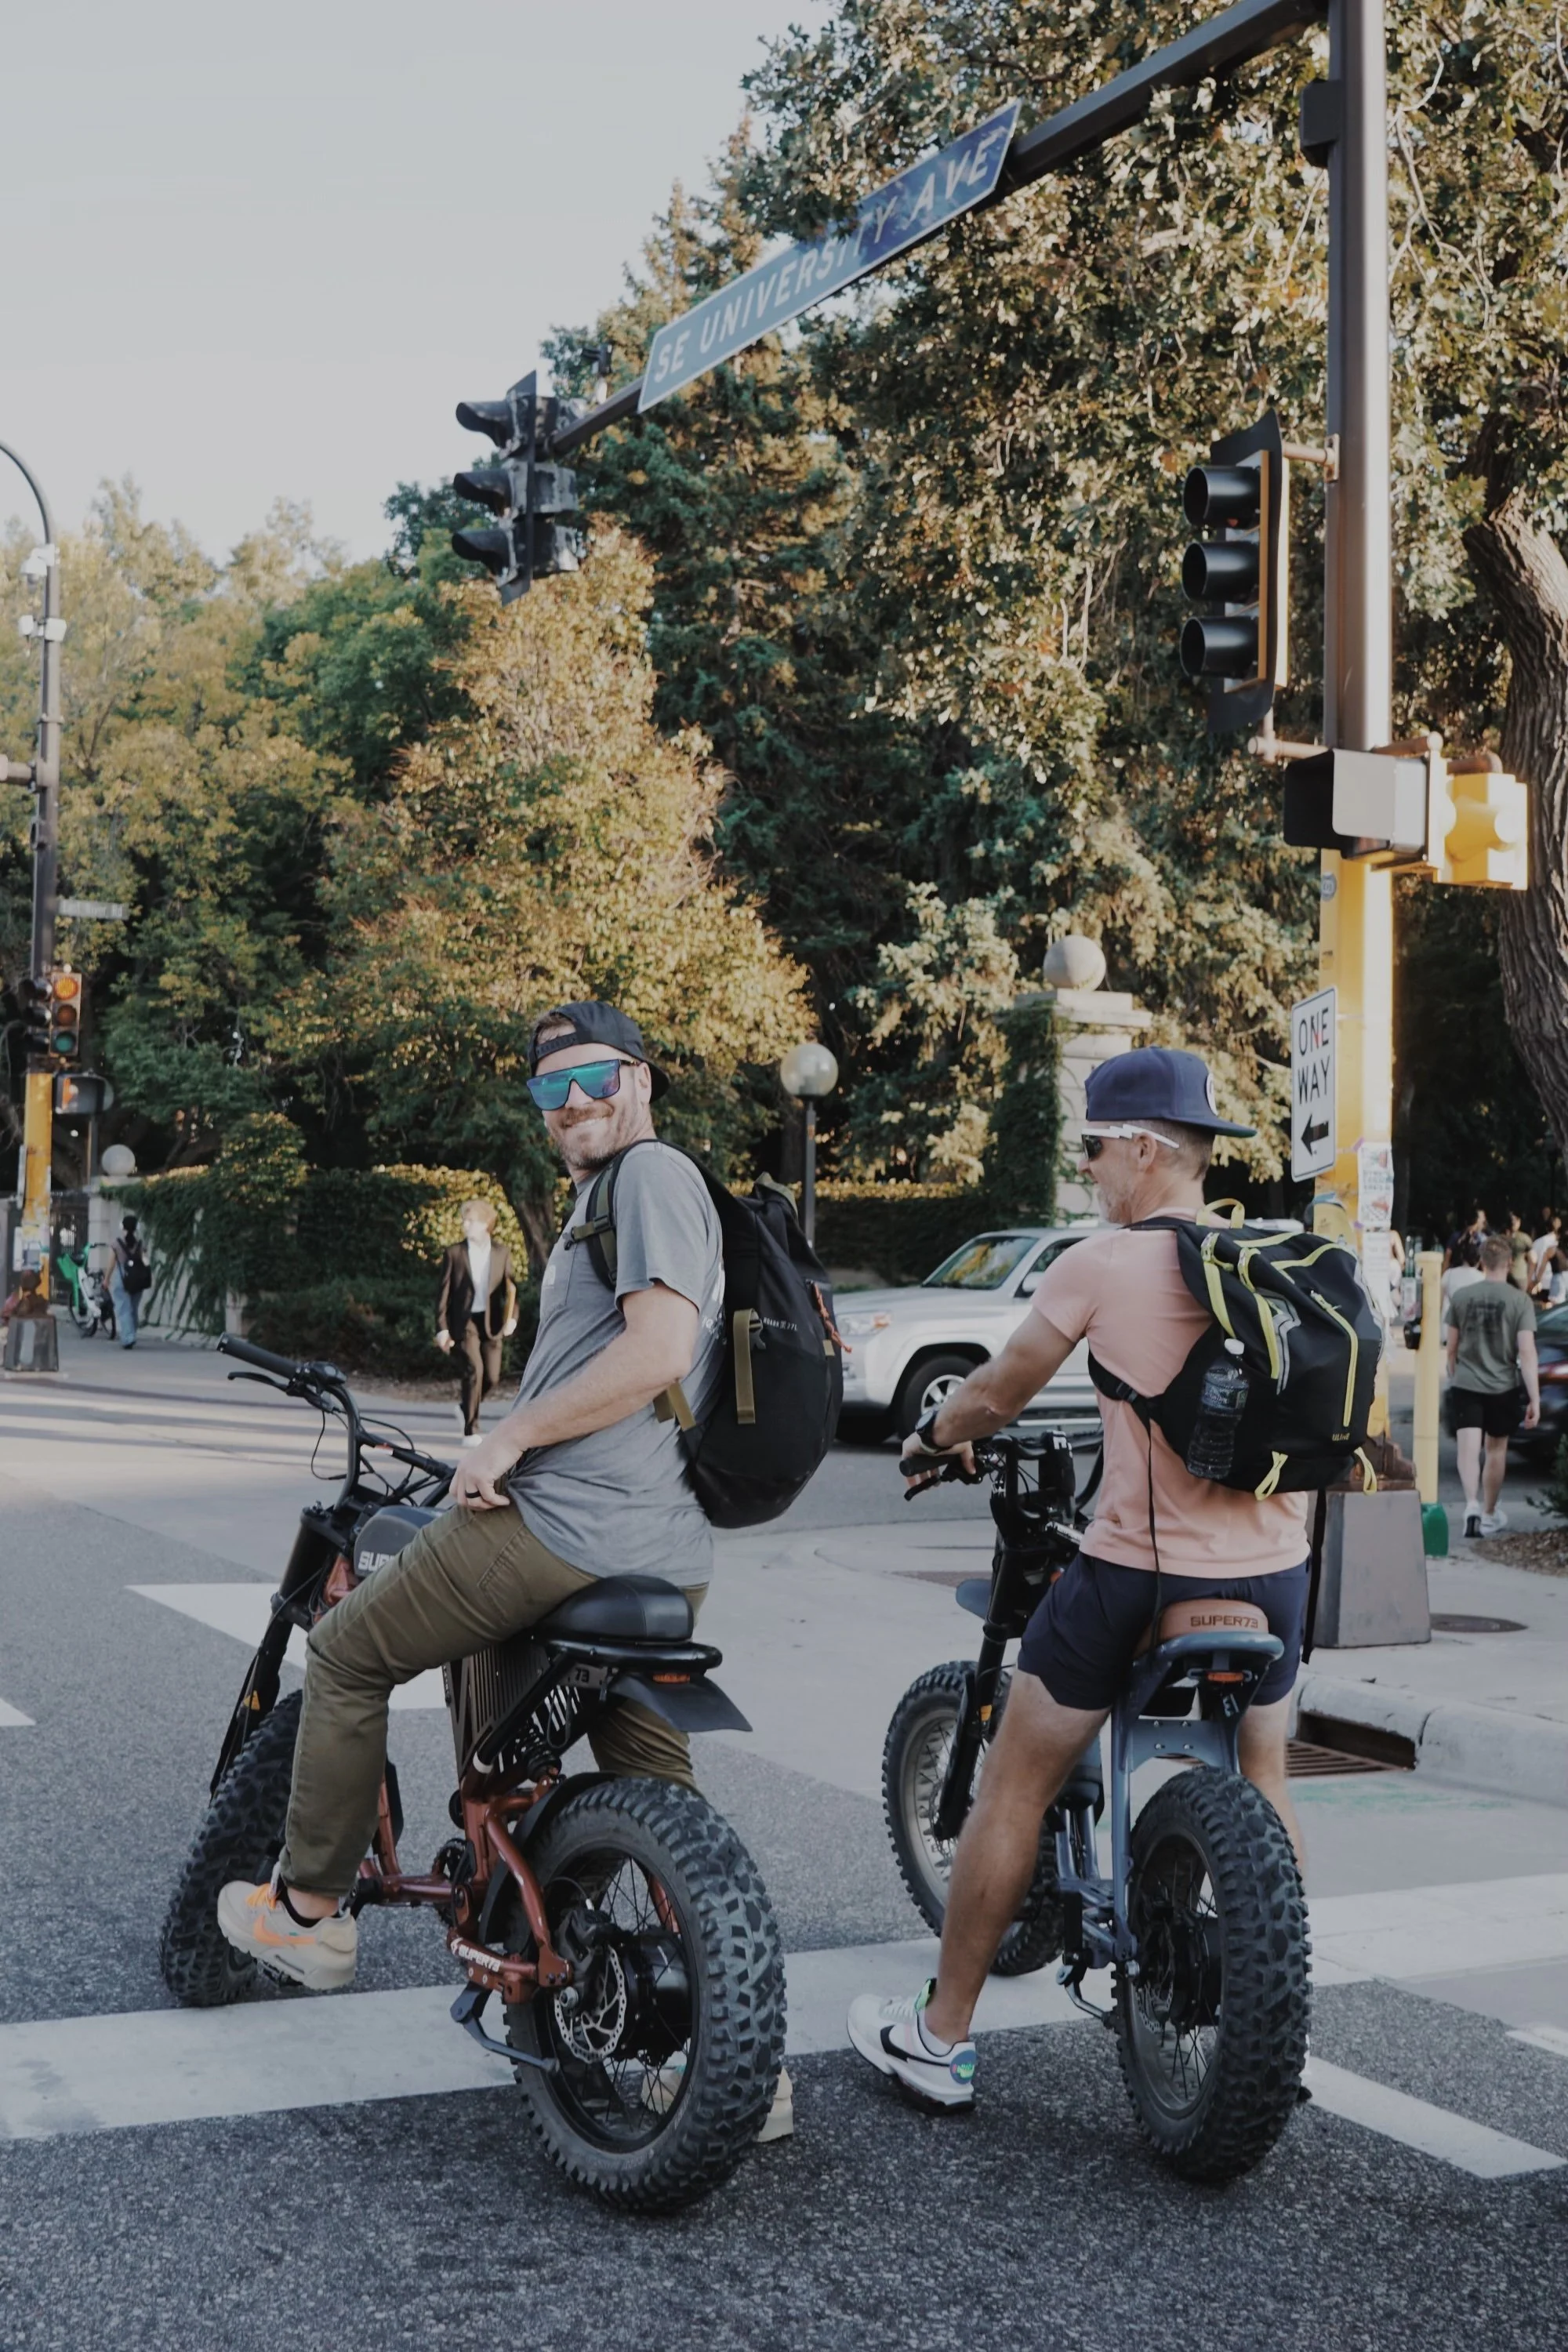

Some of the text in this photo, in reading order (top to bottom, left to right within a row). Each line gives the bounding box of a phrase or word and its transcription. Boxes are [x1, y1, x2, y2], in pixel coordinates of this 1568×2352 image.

[654, 136, 999, 383] SE UNIVERSITY AVE
[1298, 1007, 1330, 1056] ONE
[1298, 1056, 1330, 1105] WAY
[1190, 1615, 1258, 1628] SUPER73
[459, 1944, 501, 1973] SUPER73
